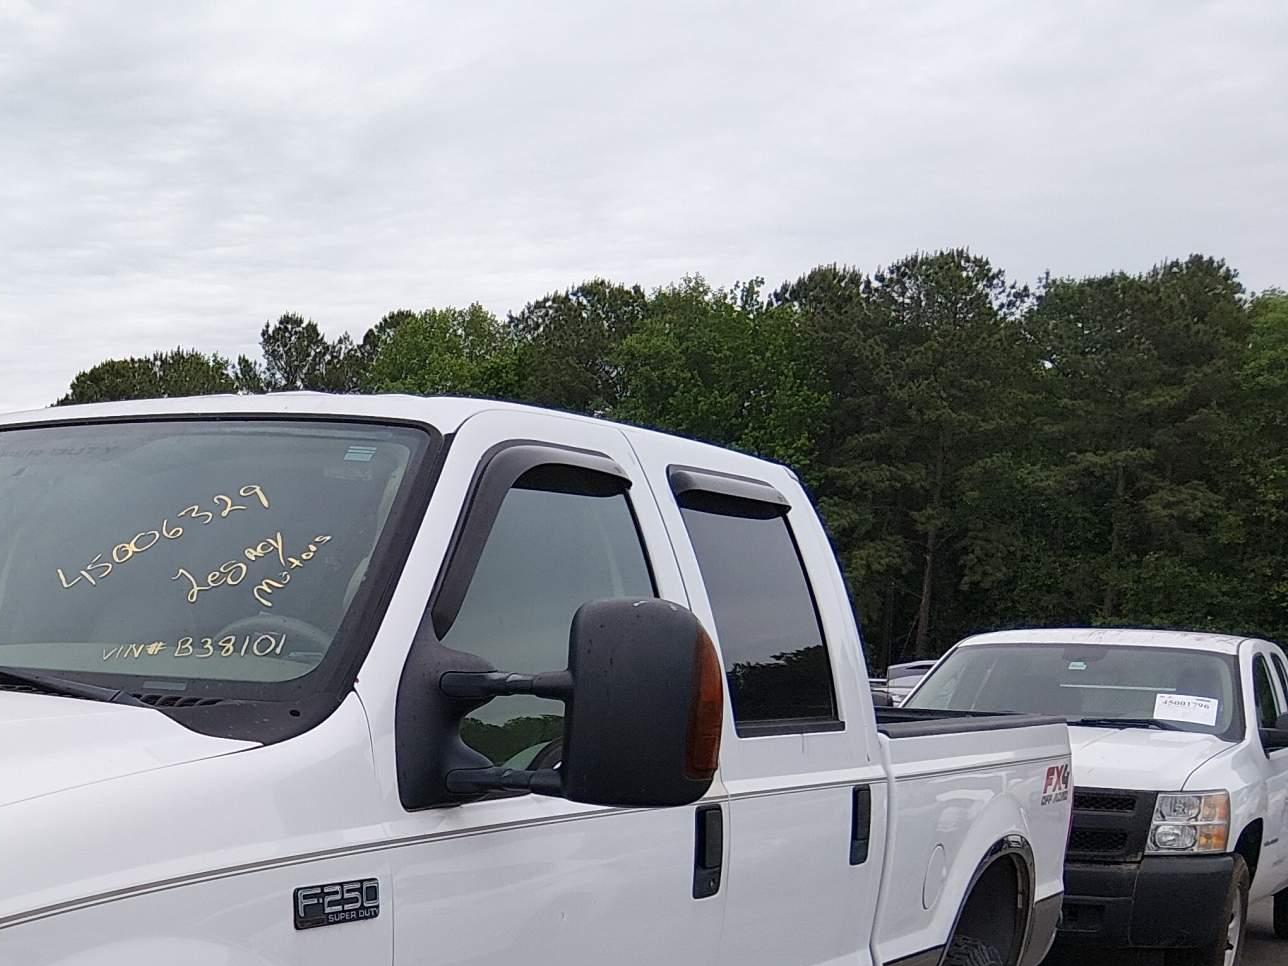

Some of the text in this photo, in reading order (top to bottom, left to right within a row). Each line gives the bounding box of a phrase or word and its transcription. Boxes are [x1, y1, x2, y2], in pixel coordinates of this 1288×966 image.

[57, 484, 269, 589] 45006329
[102, 633, 287, 662] VIN# B38101
[1042, 763, 1070, 795] FX4
[298, 880, 380, 918] F-250
[328, 910, 357, 923] SUPER
